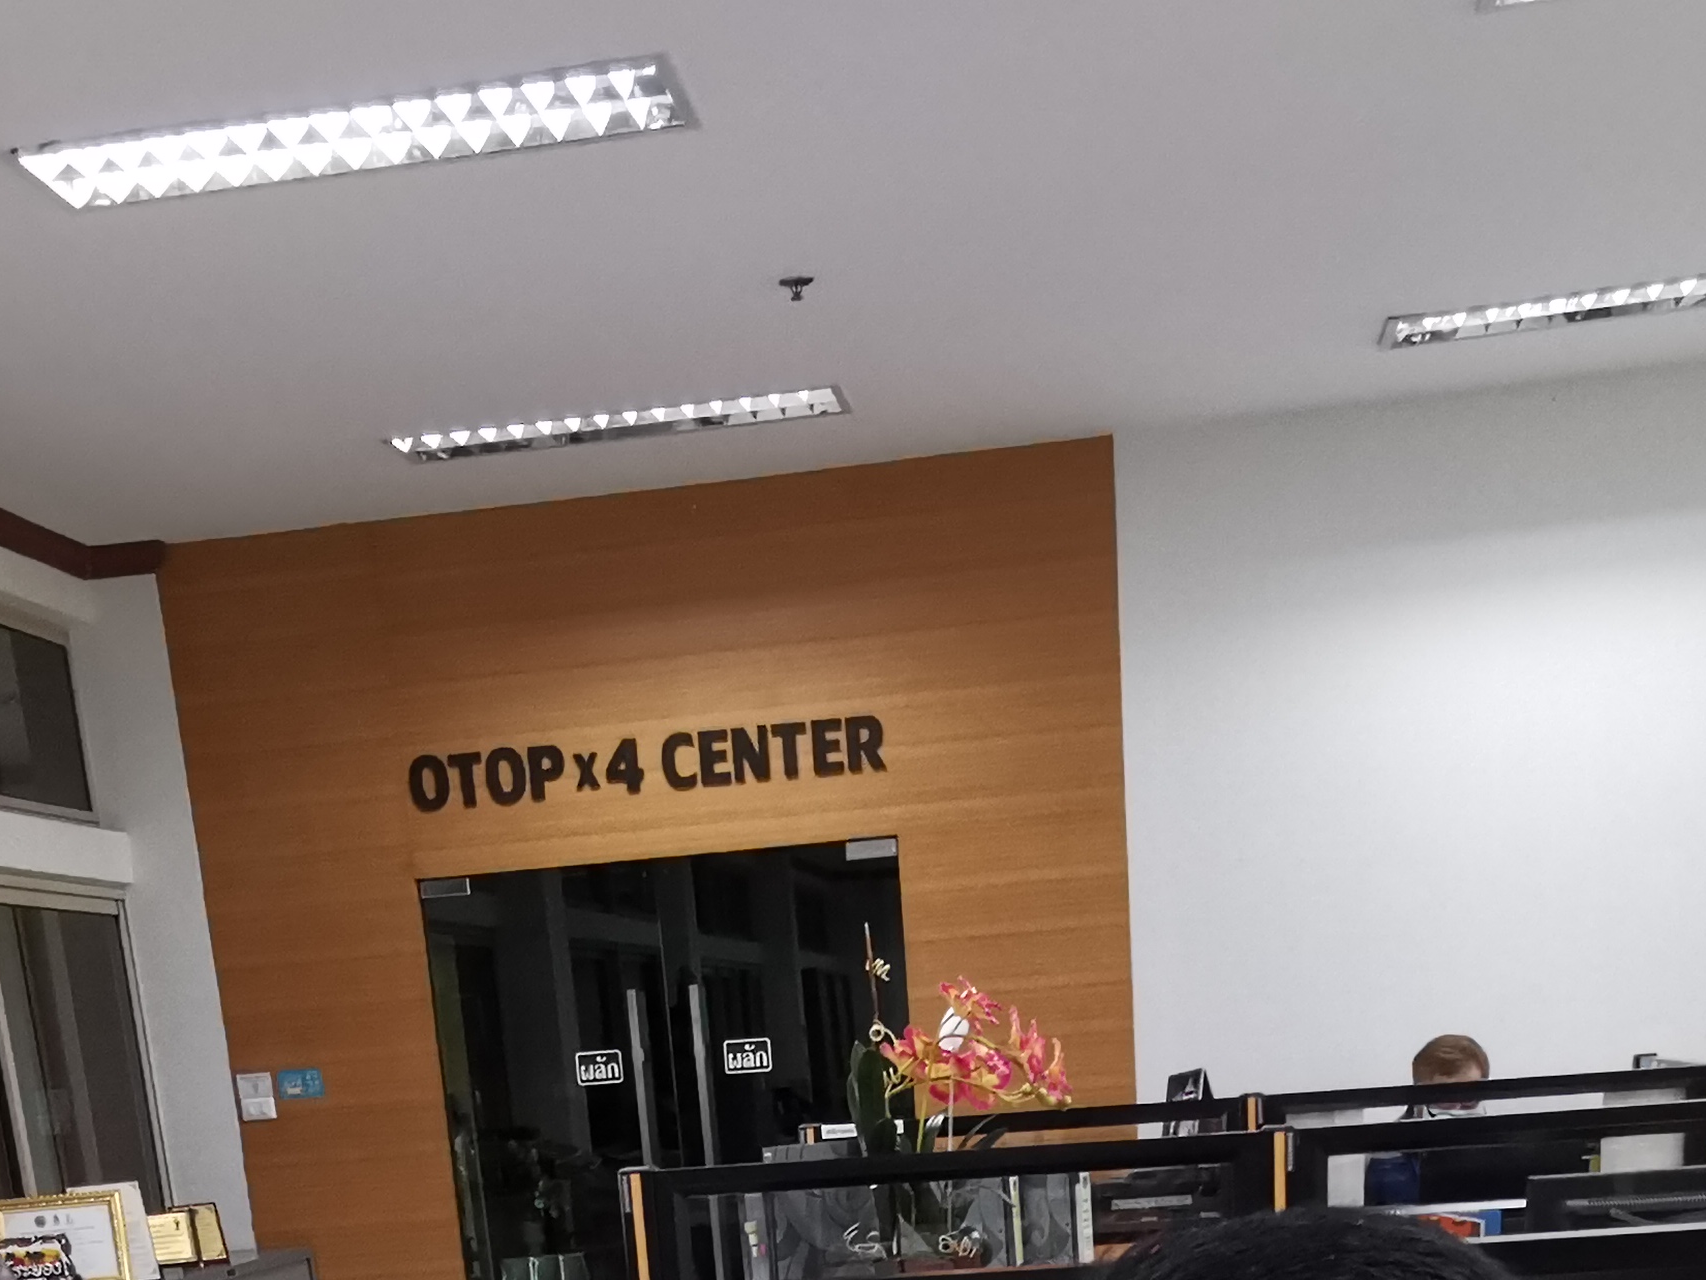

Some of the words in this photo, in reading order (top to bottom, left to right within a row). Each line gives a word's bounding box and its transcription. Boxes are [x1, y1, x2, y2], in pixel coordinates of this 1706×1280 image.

[661, 715, 889, 792] CENTER
[580, 1054, 620, 1081] ผลัก
[728, 1043, 769, 1070] ผลัก
